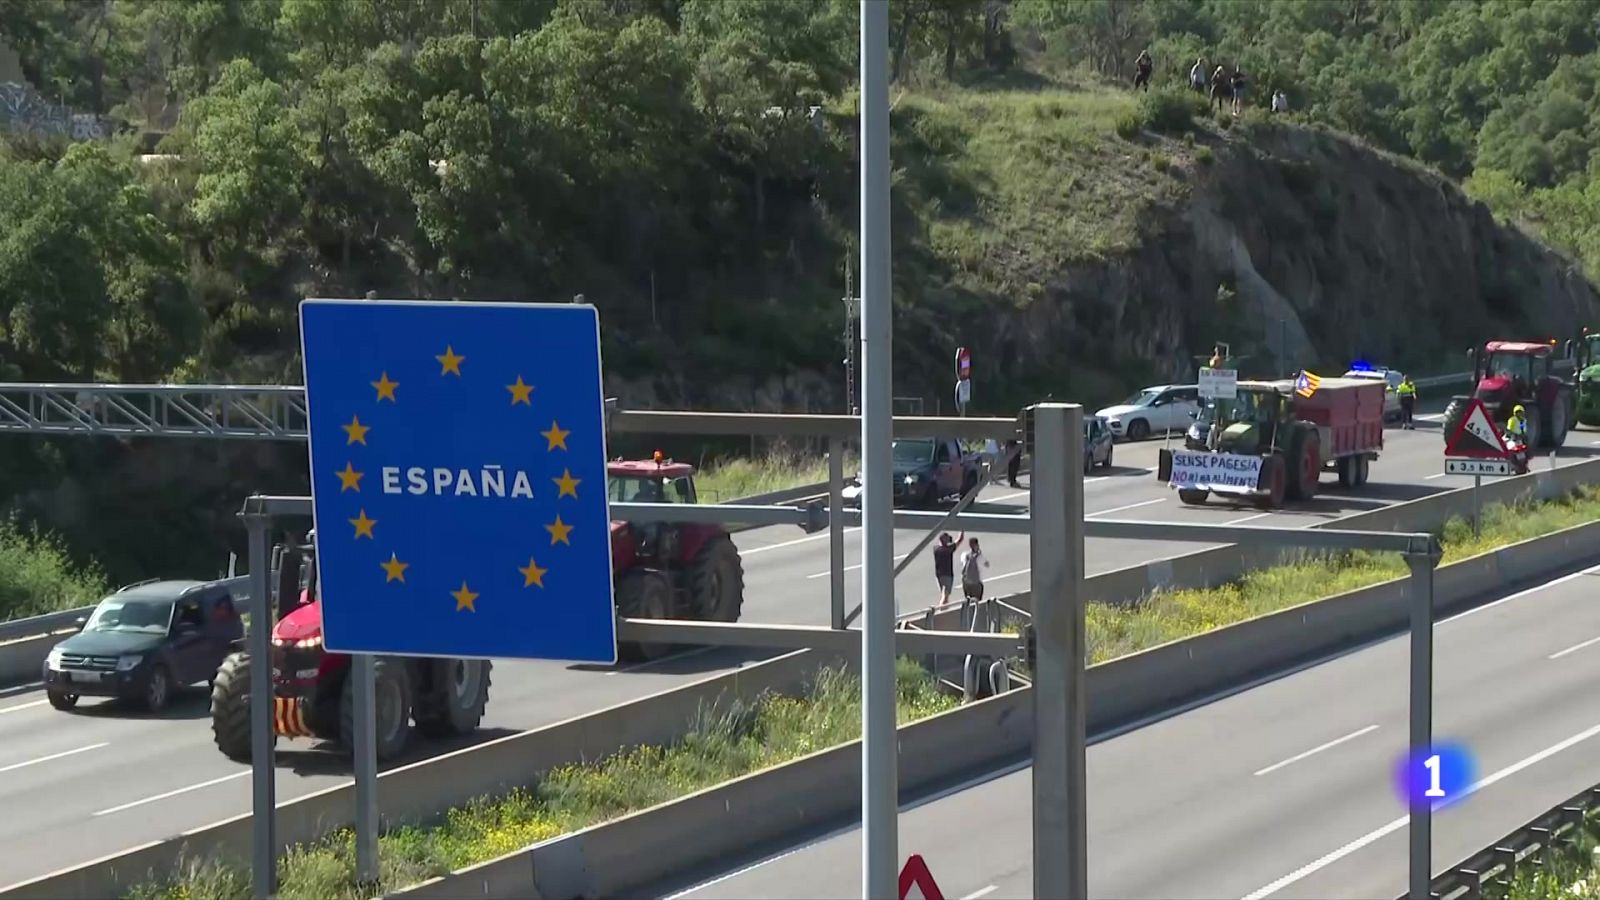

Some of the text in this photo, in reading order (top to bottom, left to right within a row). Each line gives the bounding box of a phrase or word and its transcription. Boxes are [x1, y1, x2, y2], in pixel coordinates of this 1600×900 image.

[1174, 454, 1209, 468] SENSE
[1480, 463, 1495, 472] km
[382, 464, 534, 499] ESPAÑA
[1173, 471, 1187, 483] NO
